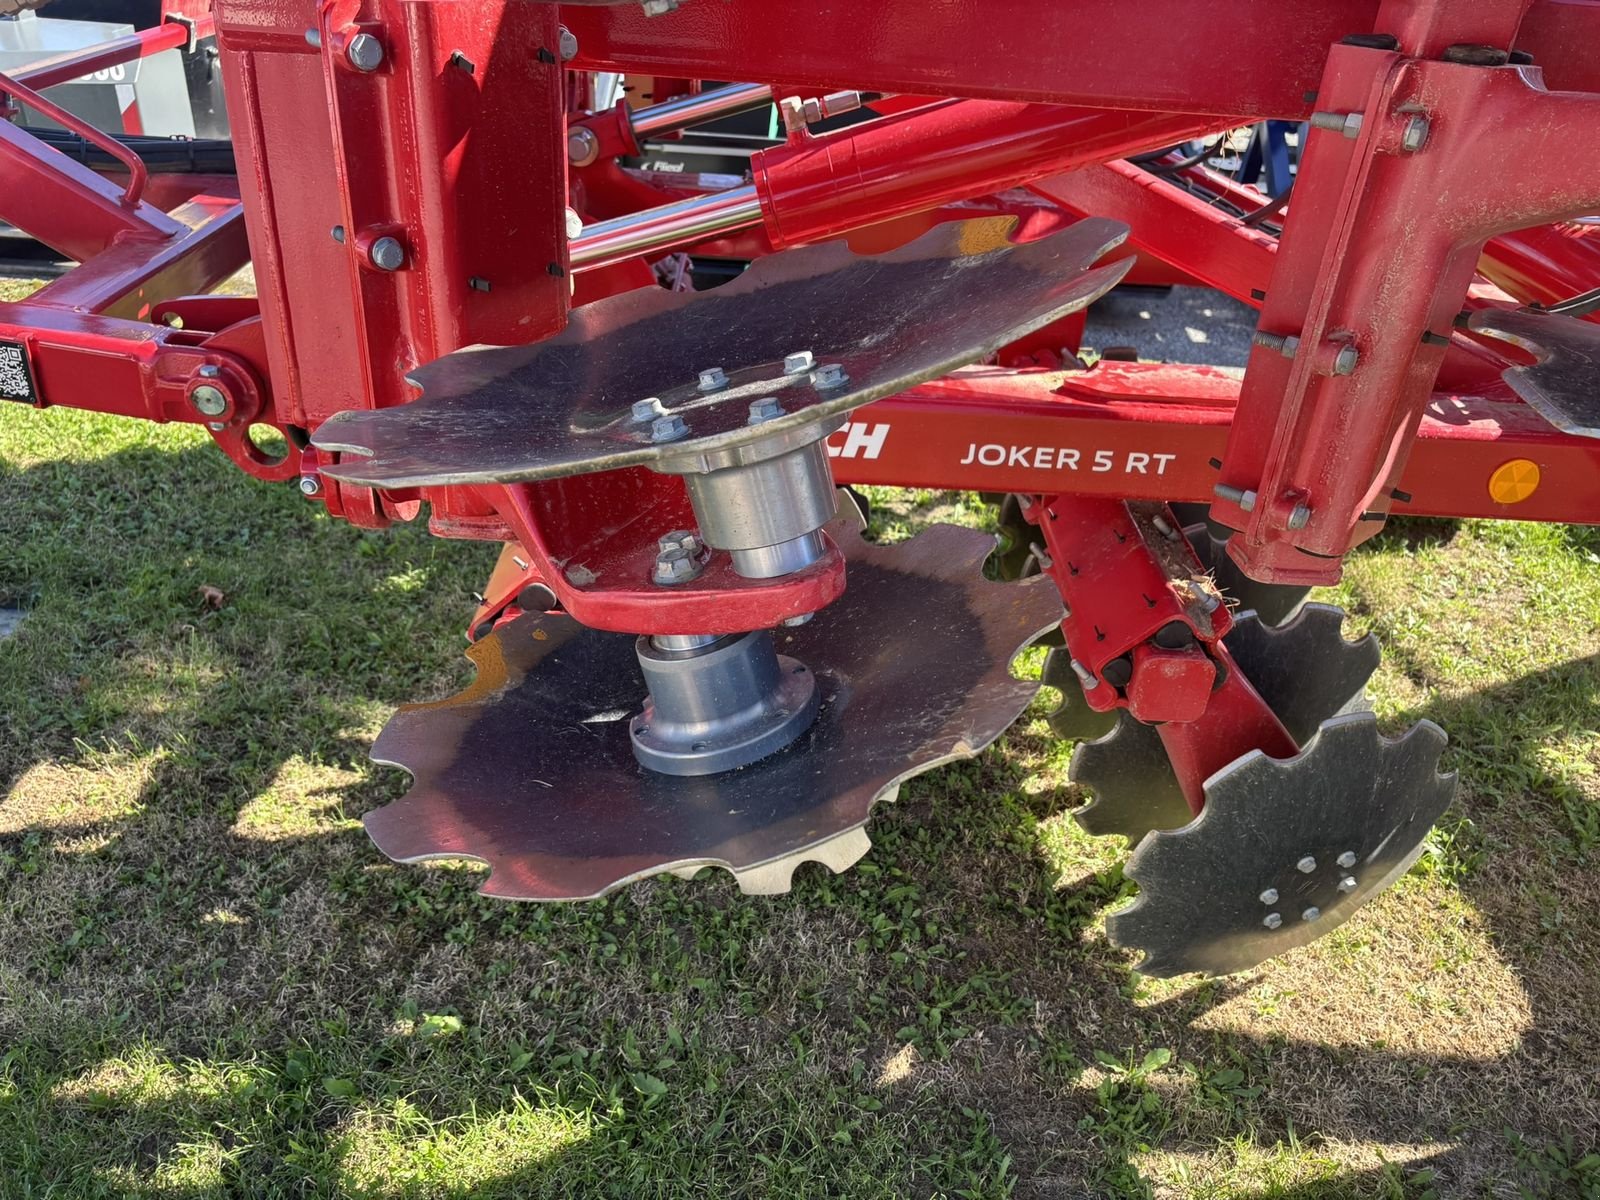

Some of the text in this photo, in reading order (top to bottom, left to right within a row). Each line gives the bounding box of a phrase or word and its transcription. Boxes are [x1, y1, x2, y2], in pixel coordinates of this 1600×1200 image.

[960, 443, 1176, 475] JOKER 5 RT
